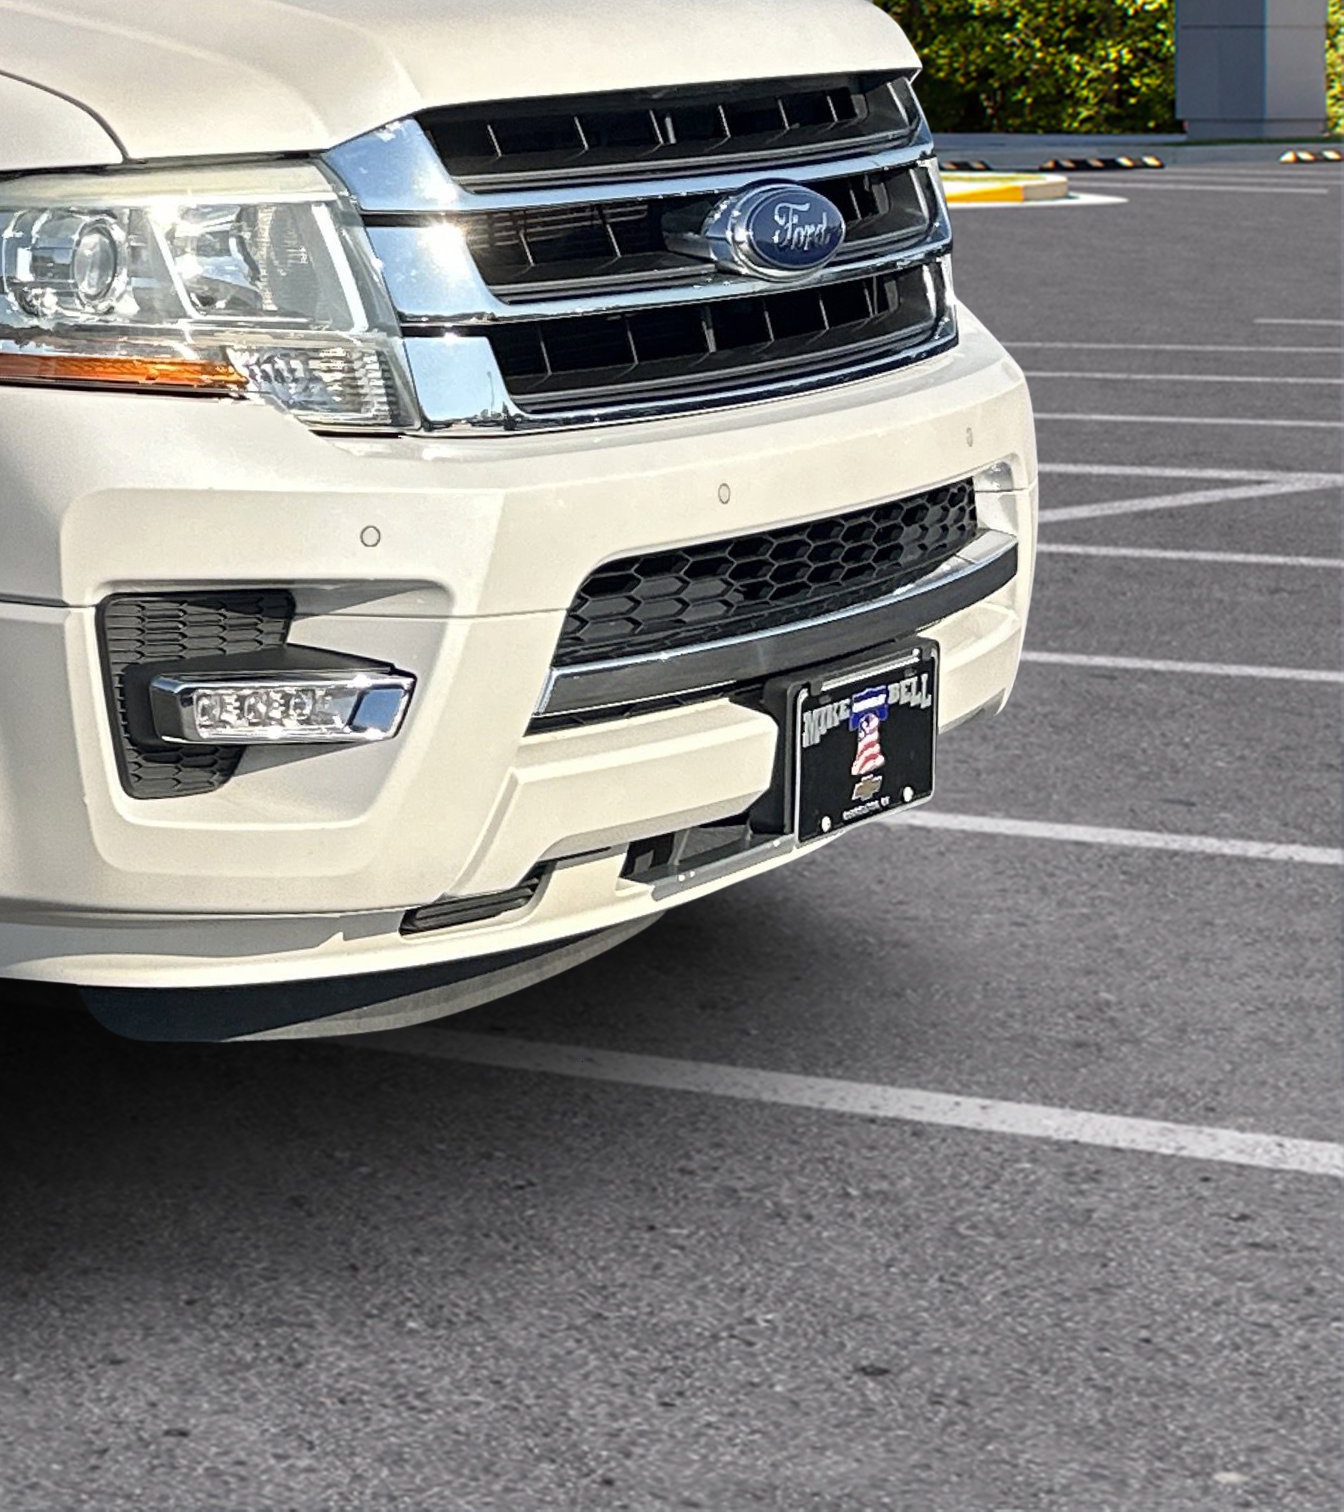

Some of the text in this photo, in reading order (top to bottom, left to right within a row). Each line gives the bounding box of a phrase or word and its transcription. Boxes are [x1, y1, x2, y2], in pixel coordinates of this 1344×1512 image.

[773, 202, 831, 251] Ford
[802, 673, 933, 748] MIKE BELL
